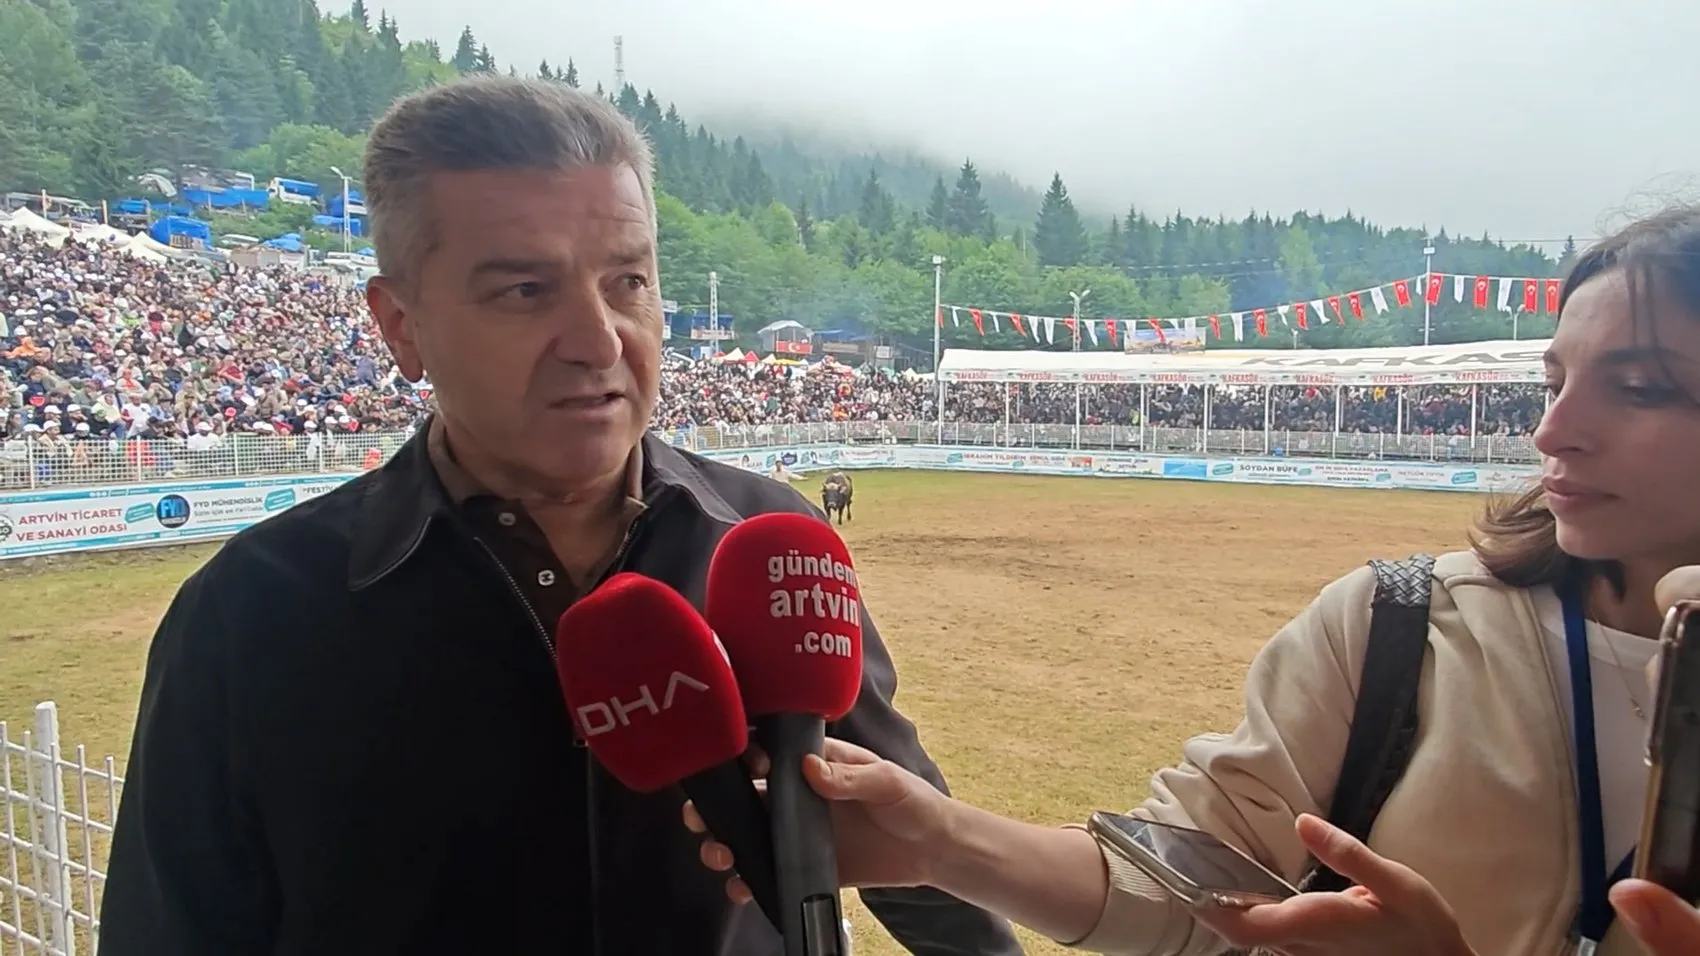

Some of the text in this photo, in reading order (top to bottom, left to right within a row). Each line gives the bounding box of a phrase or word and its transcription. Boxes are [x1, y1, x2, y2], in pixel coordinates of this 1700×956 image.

[1239, 464, 1275, 472] SOYDAN
[19, 512, 68, 525] ARTVİN
[71, 508, 123, 521] TİCARET
[16, 523, 128, 542] VE SANAYİ ODASI
[767, 550, 857, 586] gündem
[770, 583, 860, 627] artvin
[794, 631, 852, 658] .com
[577, 671, 710, 736] DHA
